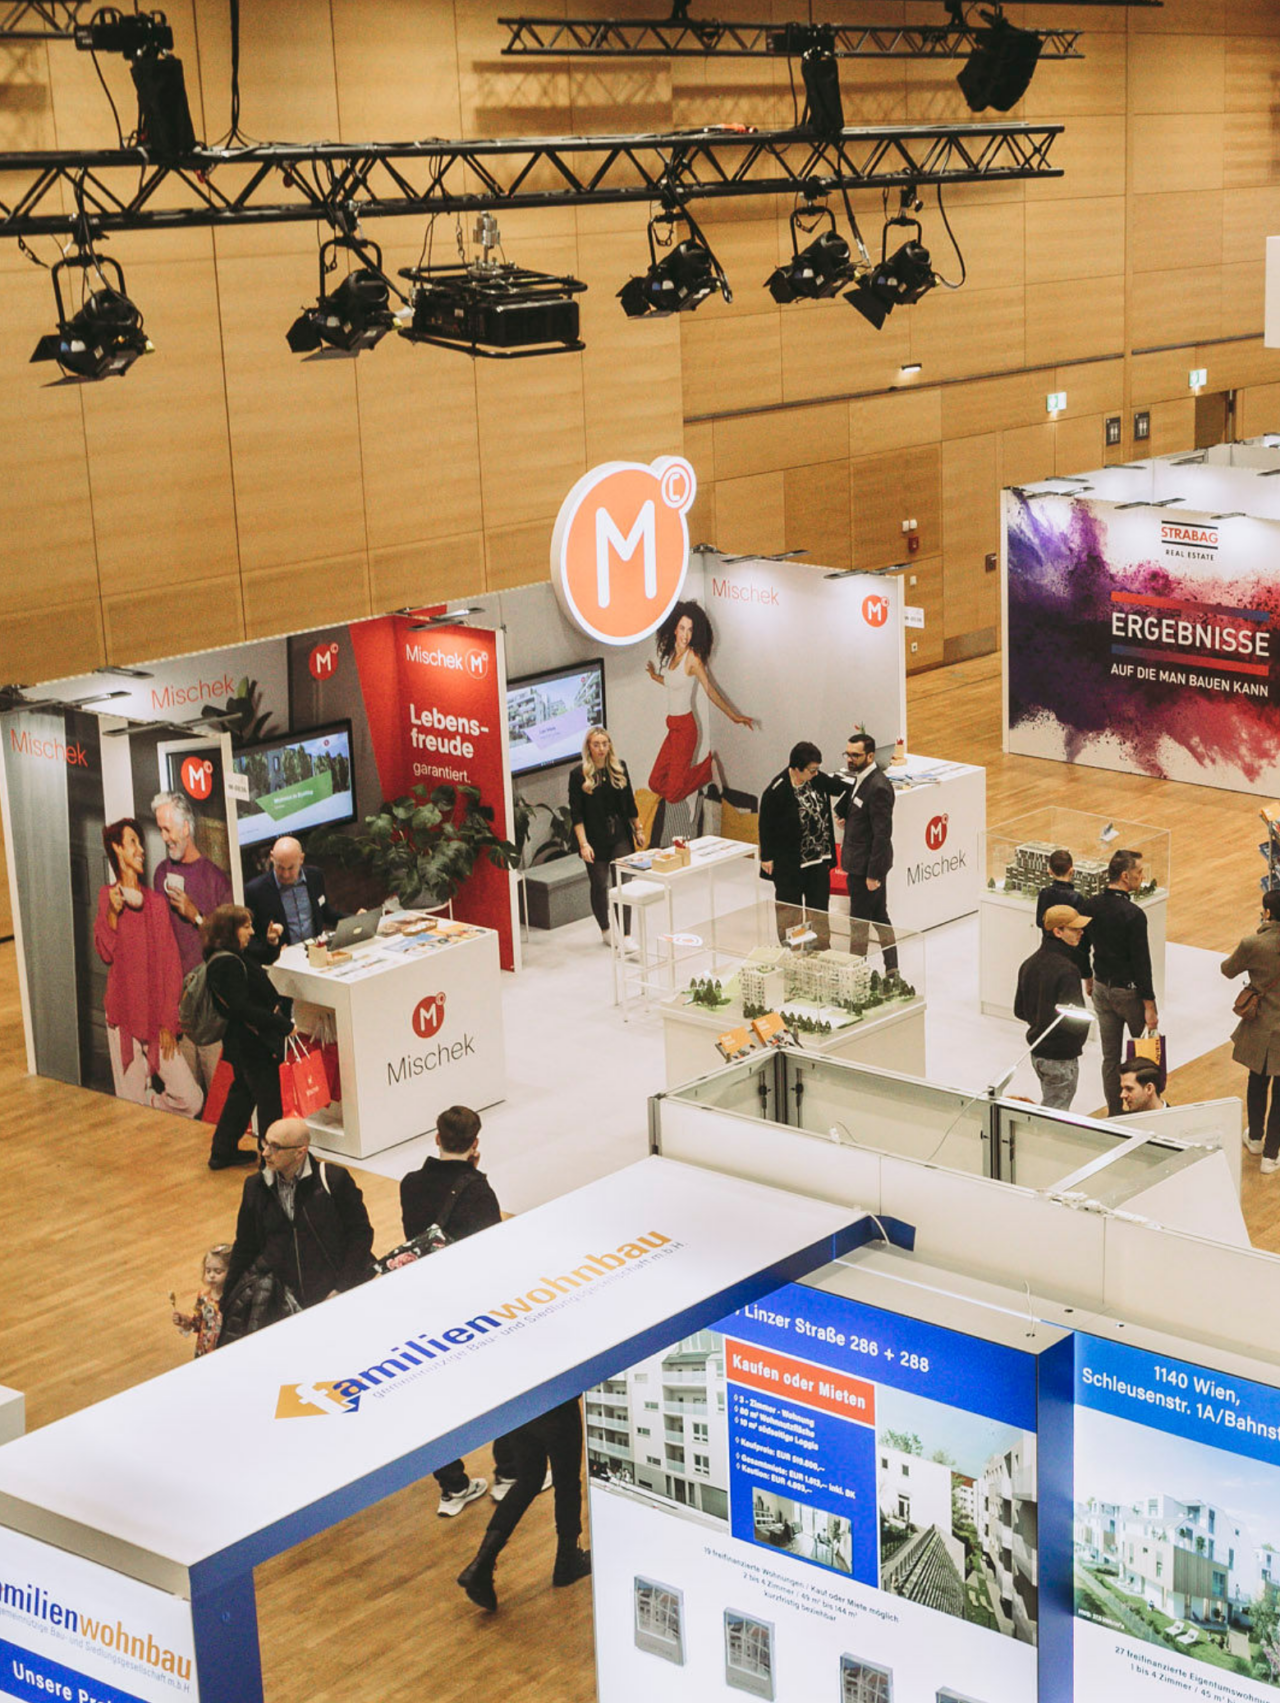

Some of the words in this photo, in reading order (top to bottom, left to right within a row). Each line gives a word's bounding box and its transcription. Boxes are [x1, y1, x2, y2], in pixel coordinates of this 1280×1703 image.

[1161, 526, 1219, 544] STRABAG
[1165, 549, 1185, 558] REAL
[1187, 552, 1215, 561] ESTATE
[712, 578, 780, 606] Mischek
[1112, 612, 1270, 657] ERGEBNISSE
[405, 644, 463, 670] Mischek
[151, 674, 235, 710] Mischek
[1110, 663, 1135, 677] AUF
[1137, 666, 1156, 681] DIE
[1159, 670, 1186, 685] MAN
[1189, 675, 1230, 692] BAUEN
[1233, 681, 1269, 697] KANN
[410, 704, 489, 736] Lebens-
[10, 729, 88, 767] Mischek
[410, 729, 475, 759] freude
[413, 762, 471, 784] garantiert.
[907, 850, 967, 887] Mischek
[387, 1033, 476, 1086] Mischek
[296, 1230, 673, 1413] familienwohnbau
[466, 1334, 498, 1353] Bau-
[500, 1321, 525, 1337] und
[524, 1257, 652, 1325] Siedlungsgesellschaft
[745, 1304, 791, 1329] Linzer
[795, 1317, 845, 1347] Straße
[850, 1335, 879, 1357] 286
[884, 1348, 895, 1361] +
[900, 1351, 930, 1373] 288
[732, 1354, 779, 1381] Kaufen
[783, 1373, 814, 1392] oder
[818, 1381, 866, 1410] Mieten
[1082, 1367, 1191, 1415] Schleusenstr.
[1154, 1366, 1188, 1390] 1140
[1193, 1376, 1241, 1407] Wien,
[712, 1549, 761, 1574] freifinanzierte
[762, 1568, 805, 1590] Wohnungen
[810, 1585, 828, 1597] Kauf
[828, 1591, 846, 1604] oder
[847, 1598, 867, 1612] Miete
[869, 1606, 899, 1623] möglich
[749, 1574, 760, 1584] bis
[767, 1581, 795, 1596] Zimmer
[822, 1600, 833, 1610] bis
[764, 1590, 800, 1610] kurzfristig
[801, 1605, 837, 1622] beziehbar
[50, 1624, 68, 1639] Bau-
[69, 1637, 84, 1648] und
[85, 1641, 166, 1684] Siedlungsgesellschaft
[1115, 1646, 1125, 1655] 27
[1126, 1650, 1187, 1679] freifinanzierte
[12, 1660, 73, 1701] Unsere
[1136, 1665, 1150, 1677] bis
[1159, 1673, 1192, 1691] Zimmer
[1200, 1688, 1212, 1699] 45
